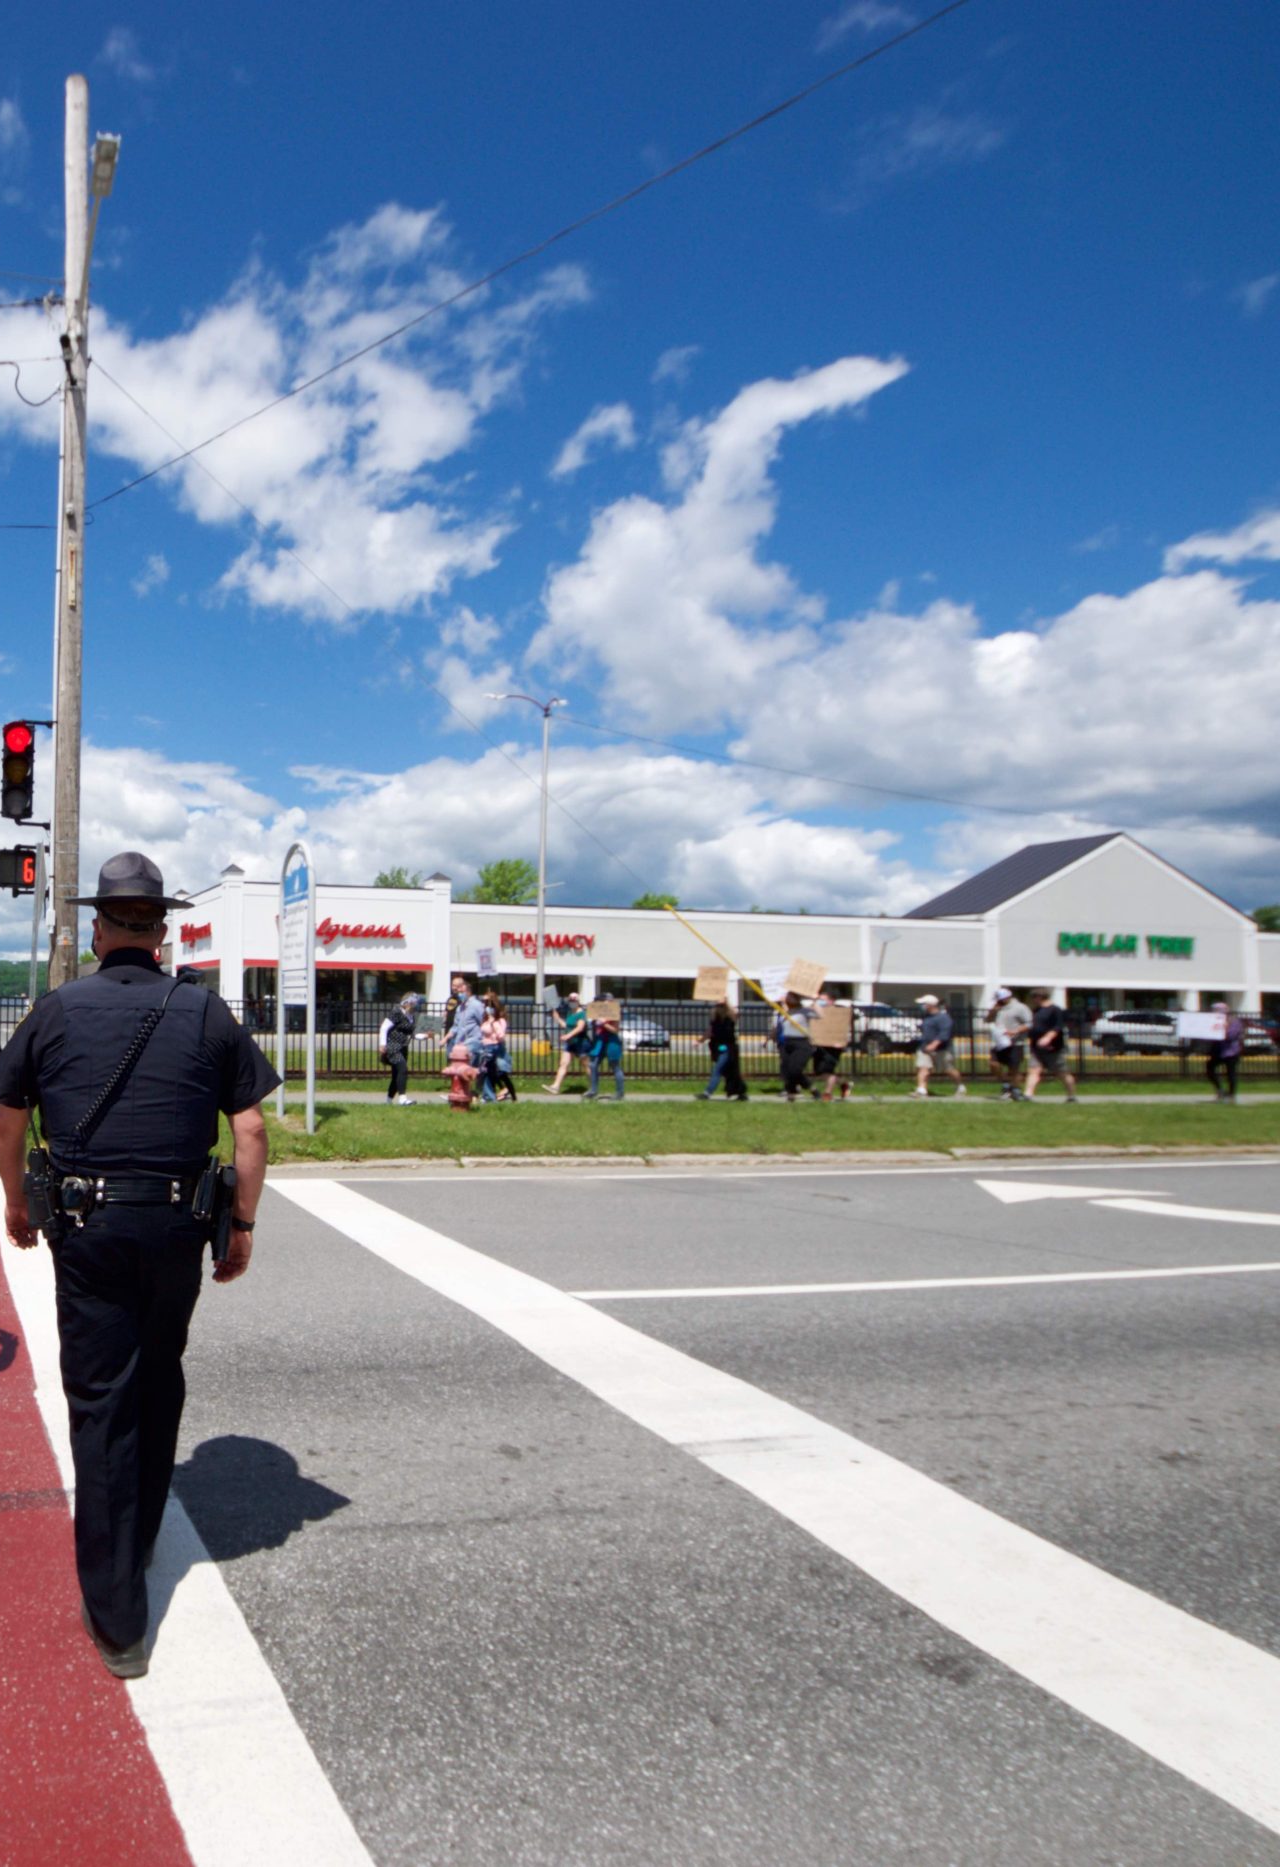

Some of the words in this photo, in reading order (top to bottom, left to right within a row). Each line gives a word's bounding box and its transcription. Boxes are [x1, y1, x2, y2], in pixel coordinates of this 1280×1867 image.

[23, 857, 34, 883] 6
[1057, 931, 1137, 953] DOLLAR
[1145, 934, 1195, 956] TREE
